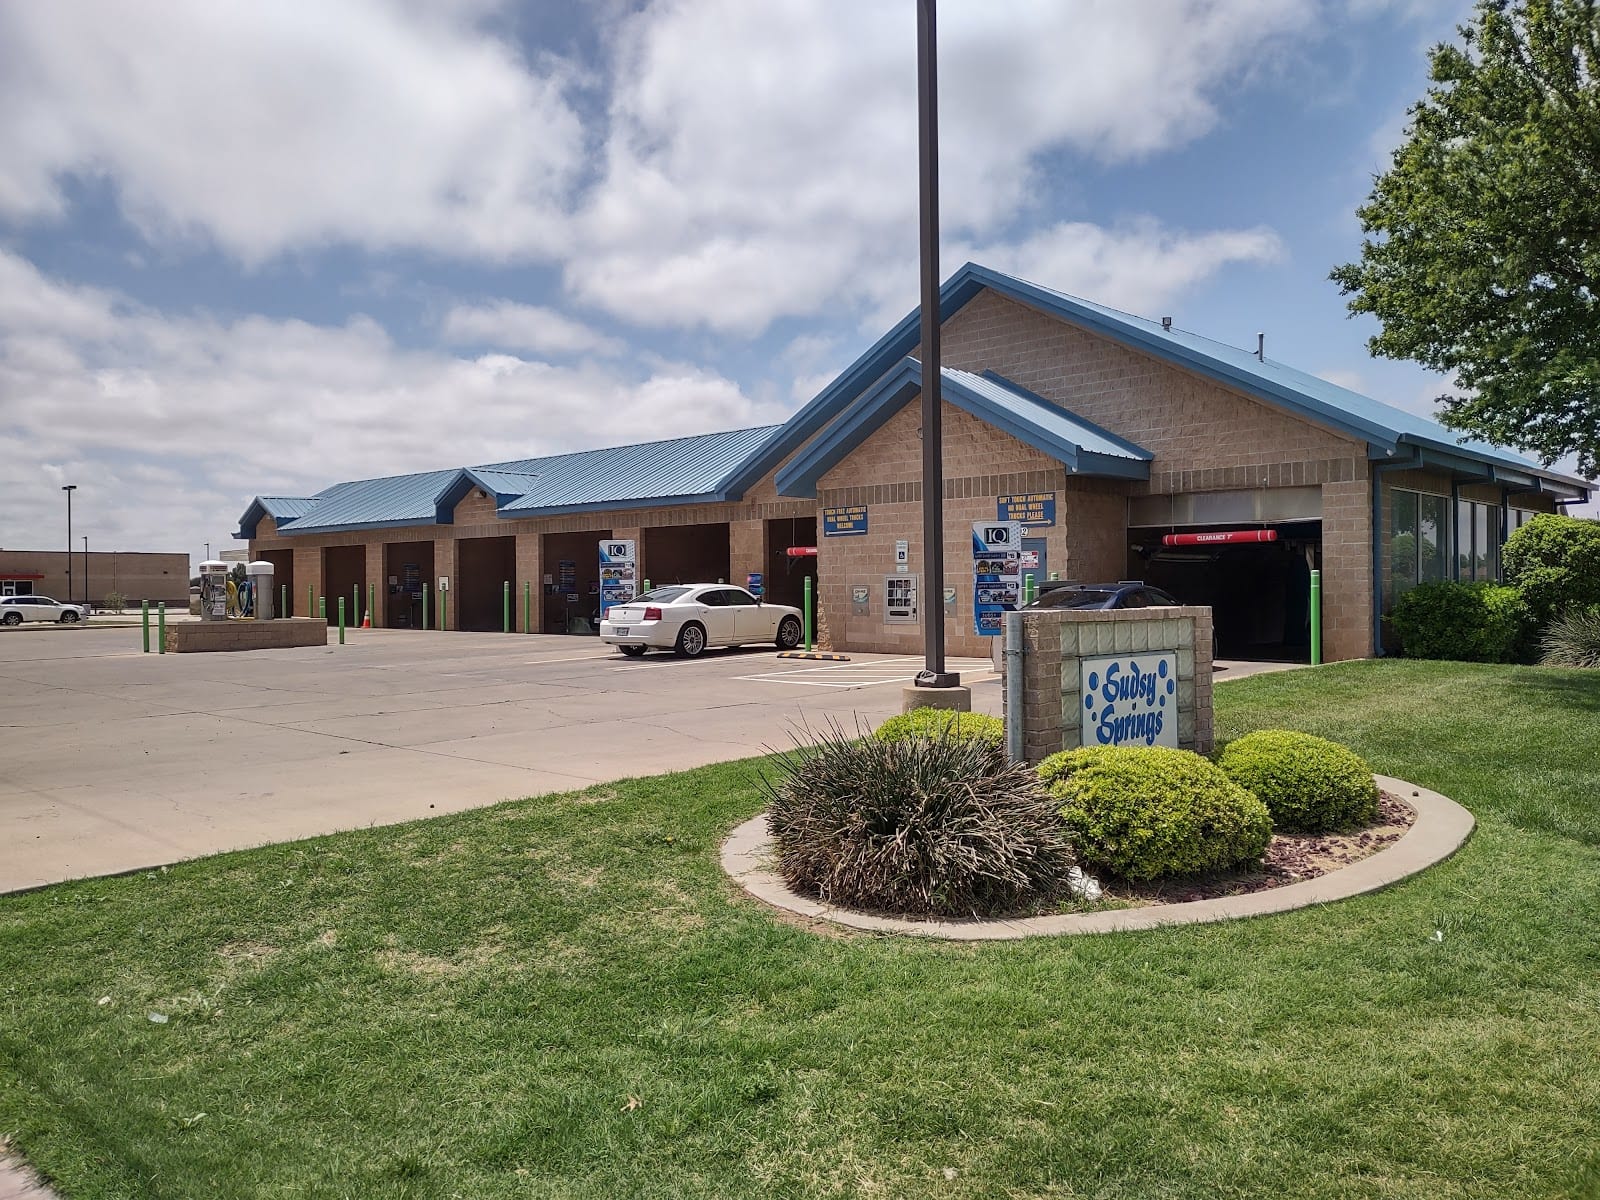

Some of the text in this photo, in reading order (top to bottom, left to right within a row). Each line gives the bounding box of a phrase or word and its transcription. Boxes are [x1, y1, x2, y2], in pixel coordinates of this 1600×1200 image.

[1011, 495, 1026, 503] TOUCH
[1027, 493, 1054, 502] AUTOMATIC
[1028, 502, 1044, 510] WHEEL
[1008, 511, 1044, 520] TRUCKS PLEASE
[988, 529, 1007, 544] IQ
[1196, 534, 1226, 542] CLEARANCE
[609, 545, 625, 557] IQ
[1102, 661, 1156, 706] Sudsy
[1096, 703, 1163, 746] Springs
